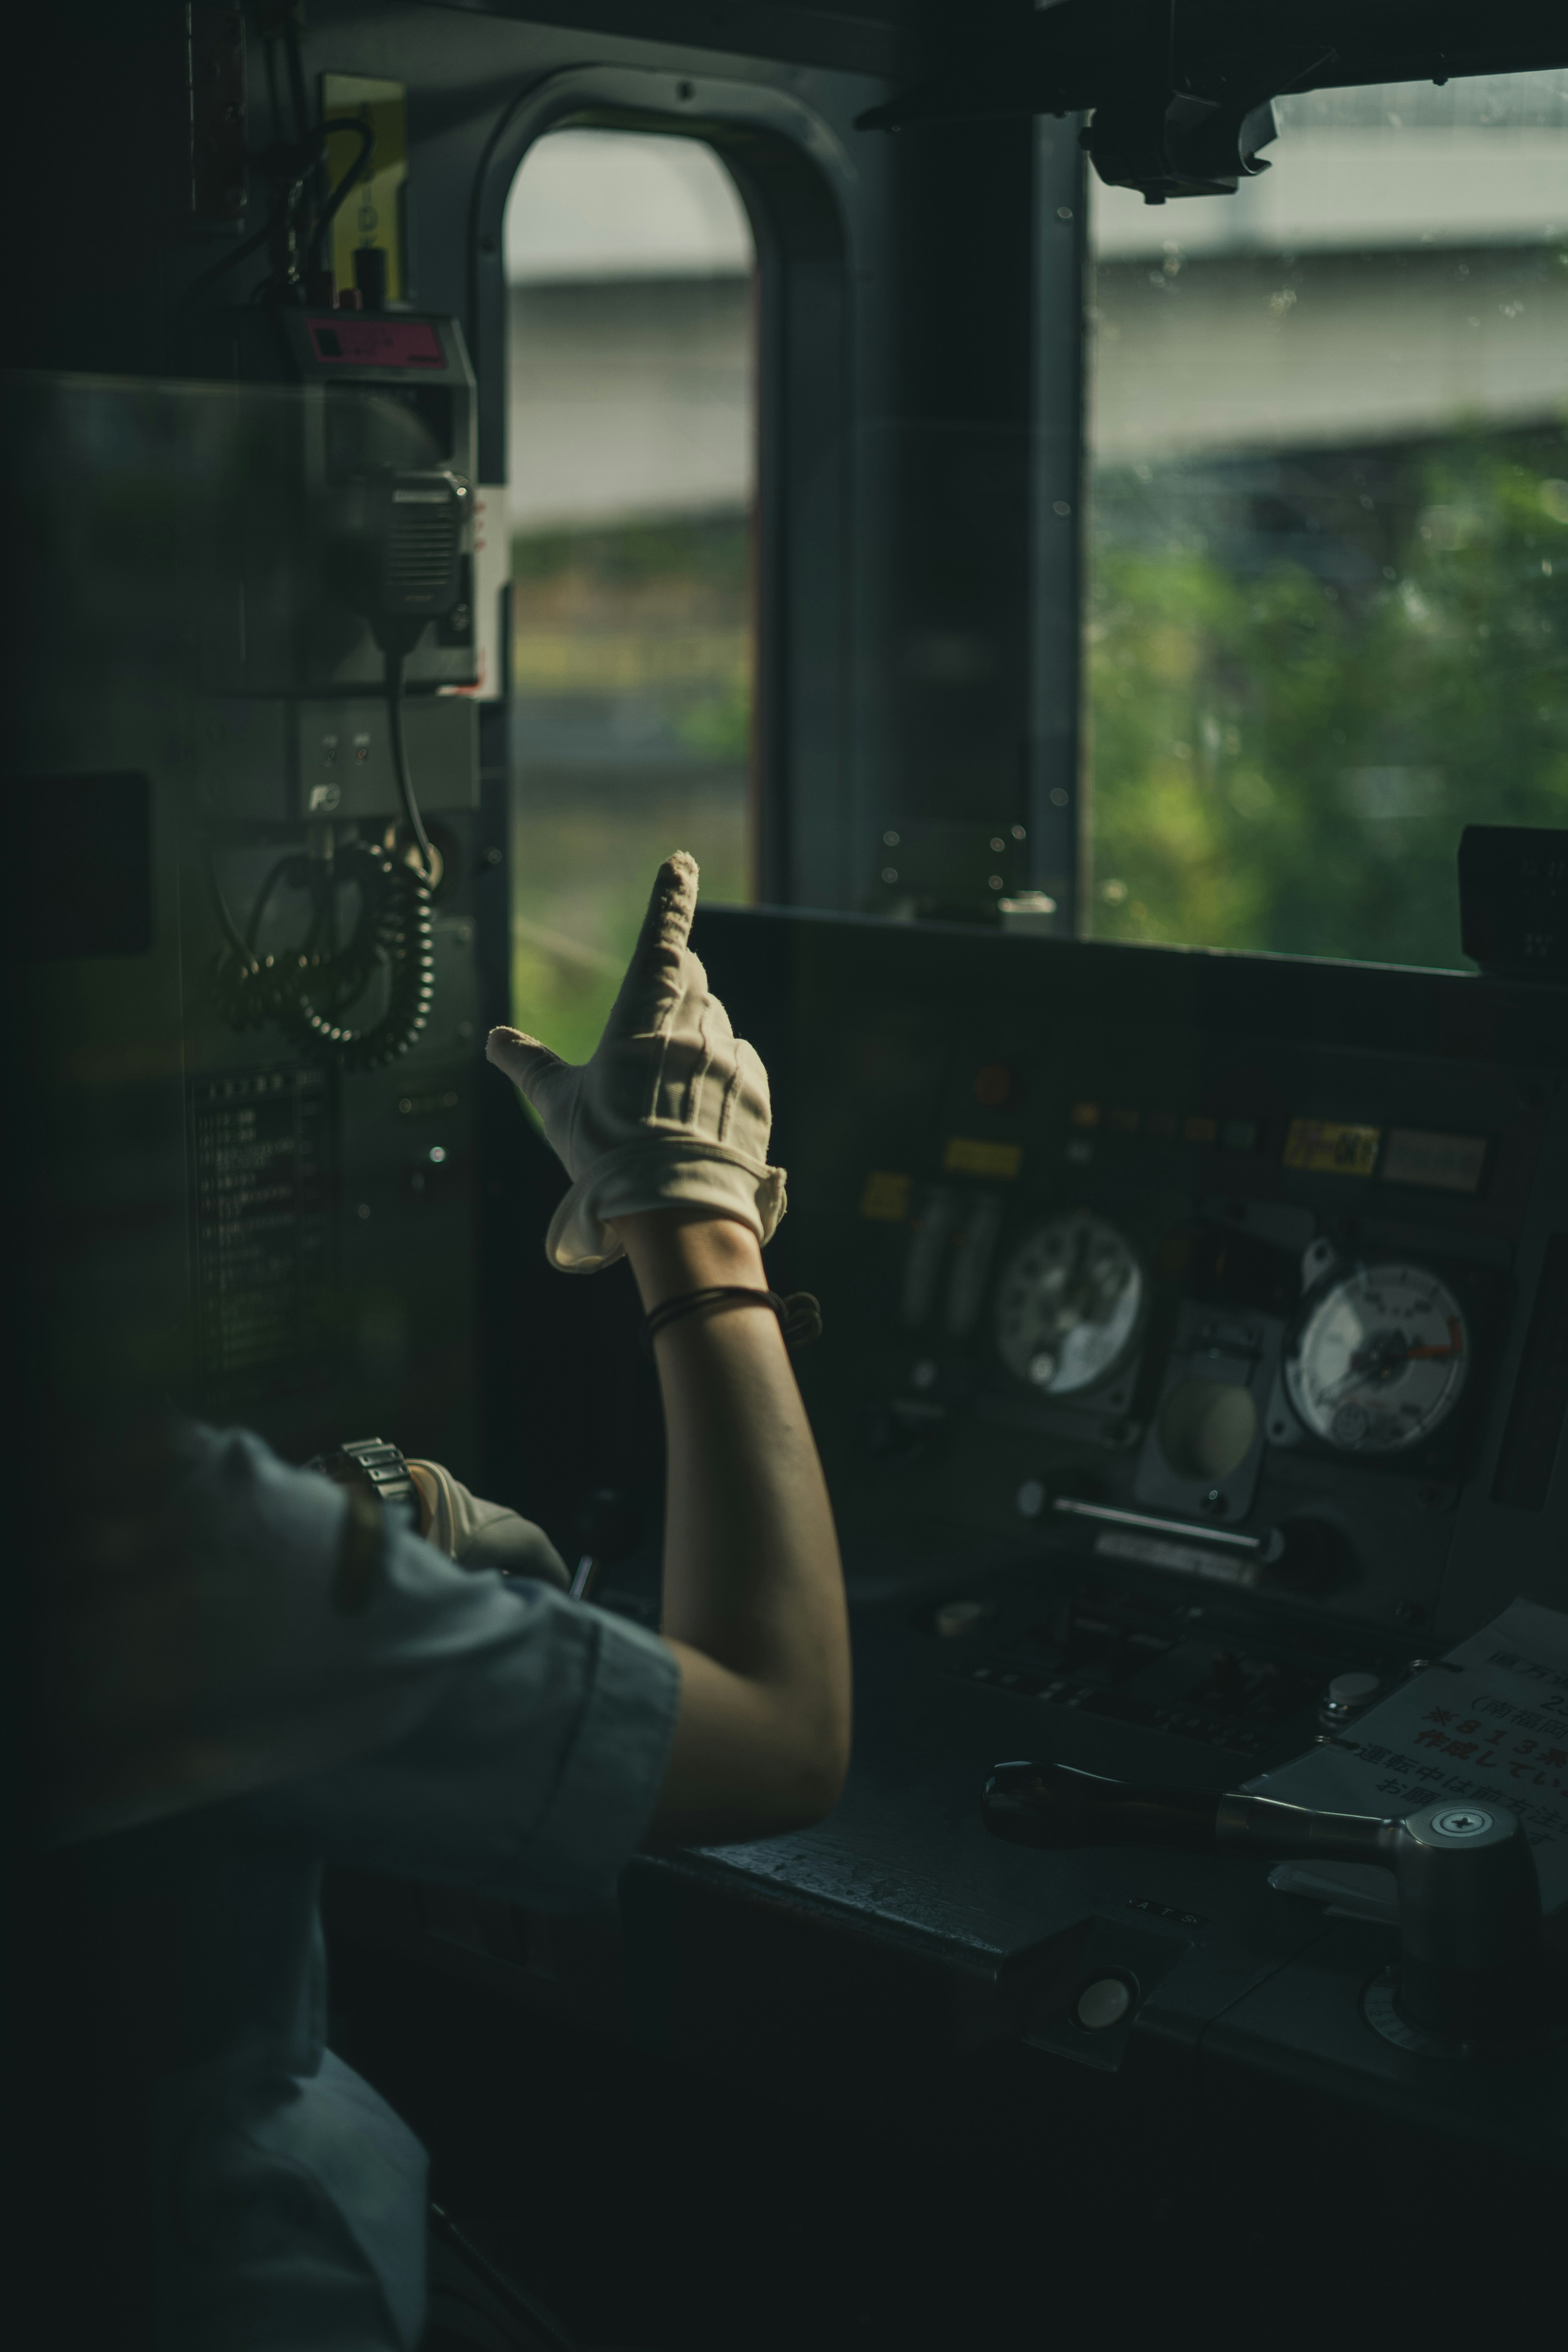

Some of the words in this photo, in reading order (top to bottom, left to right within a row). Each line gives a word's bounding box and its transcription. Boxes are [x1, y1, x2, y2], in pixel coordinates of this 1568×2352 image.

[1354, 1743, 1568, 1834] 運転中は前方注
[1414, 1729, 1568, 1797] 作成してい
[1136, 1902, 1195, 1922] ATS
